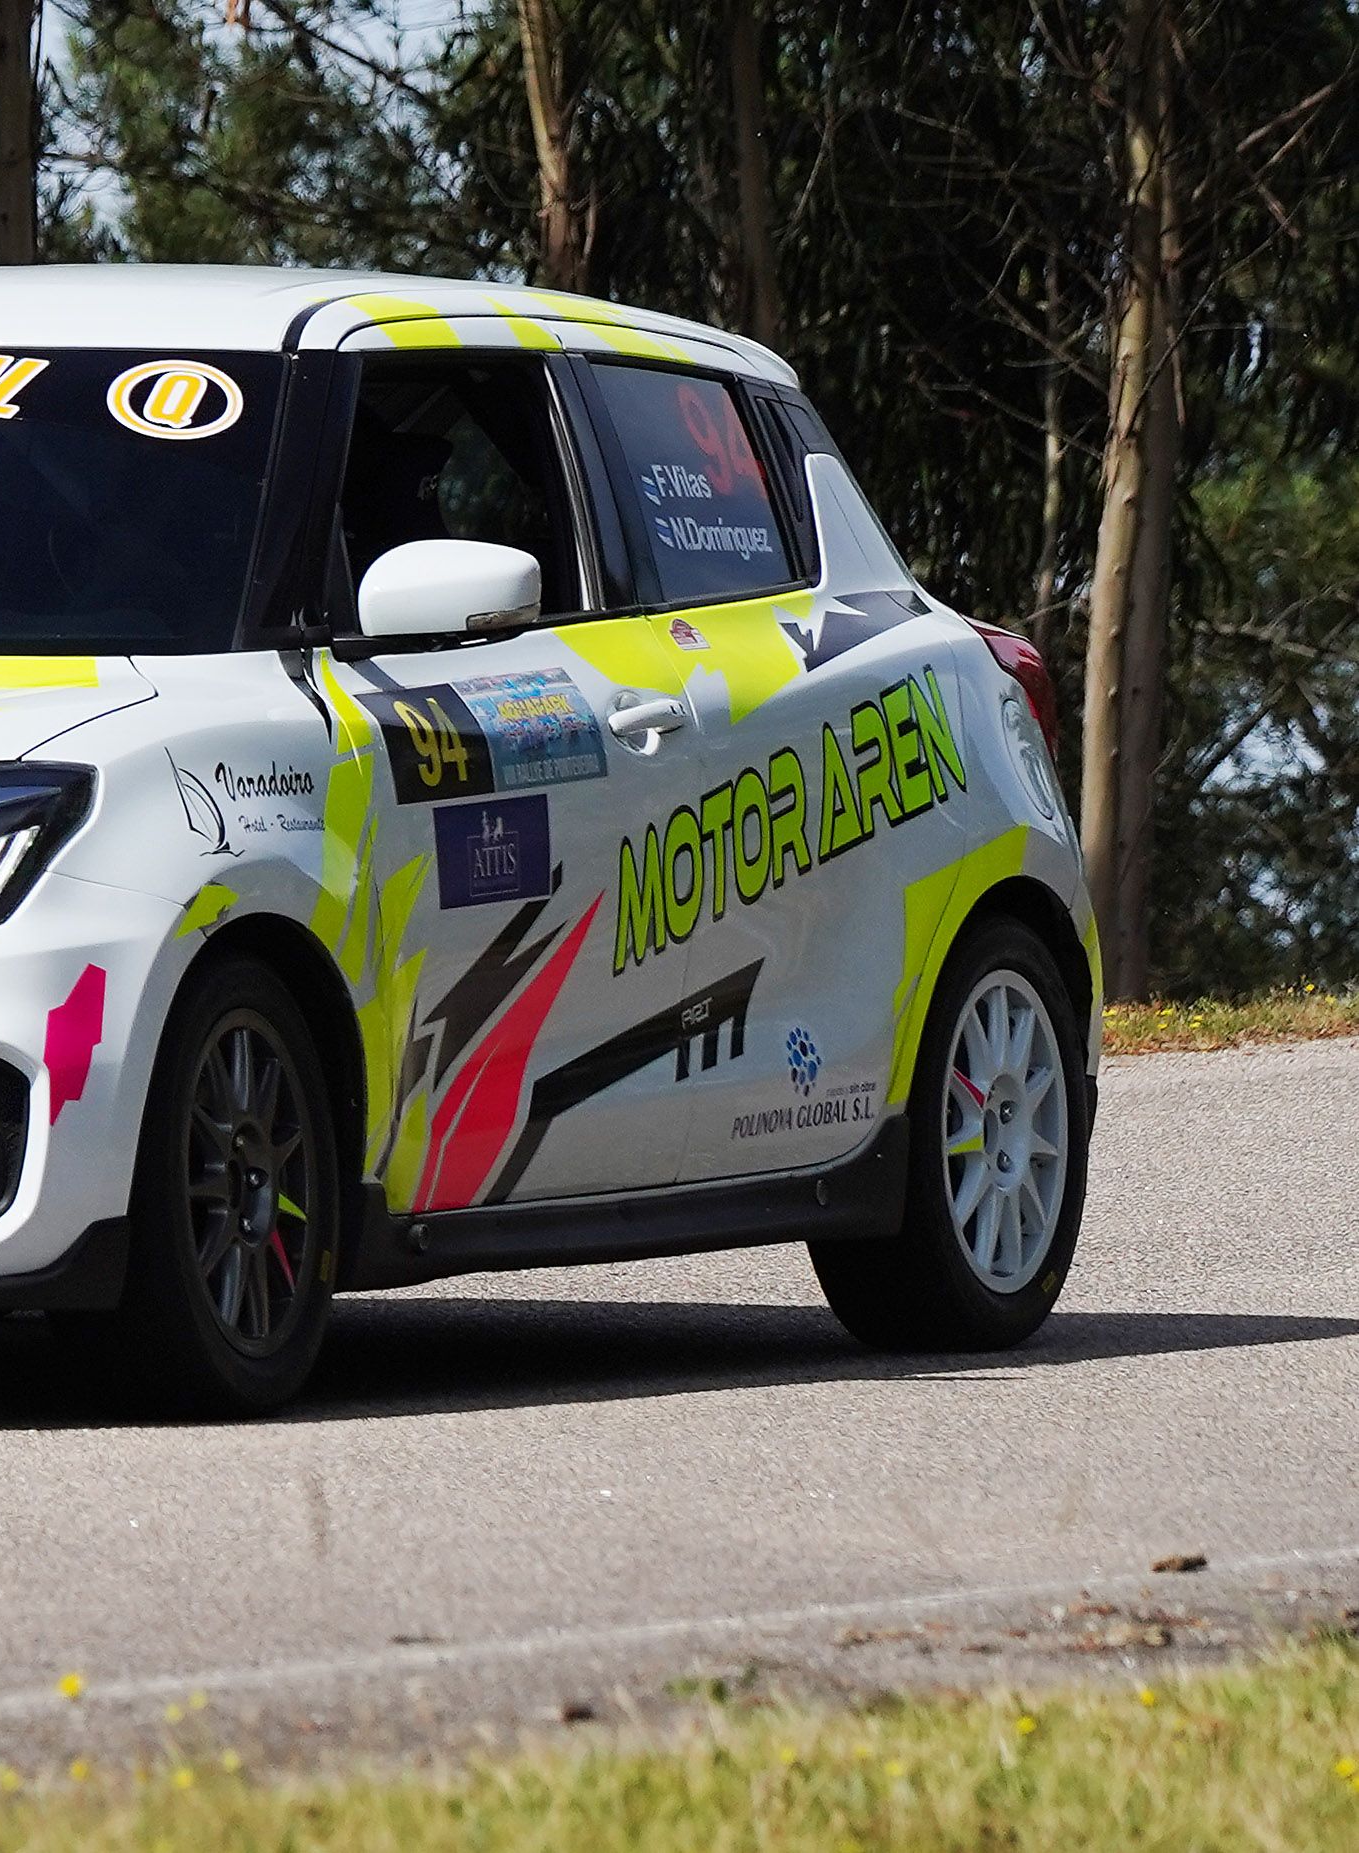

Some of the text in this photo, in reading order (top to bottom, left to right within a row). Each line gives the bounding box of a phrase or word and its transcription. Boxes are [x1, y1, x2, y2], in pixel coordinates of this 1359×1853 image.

[651, 464, 712, 499] F.Vilas
[393, 697, 468, 787] 94
[613, 663, 967, 977] MOTOR AREN
[796, 1098, 847, 1129] GLOBAL
[851, 1096, 875, 1122] S.L.
